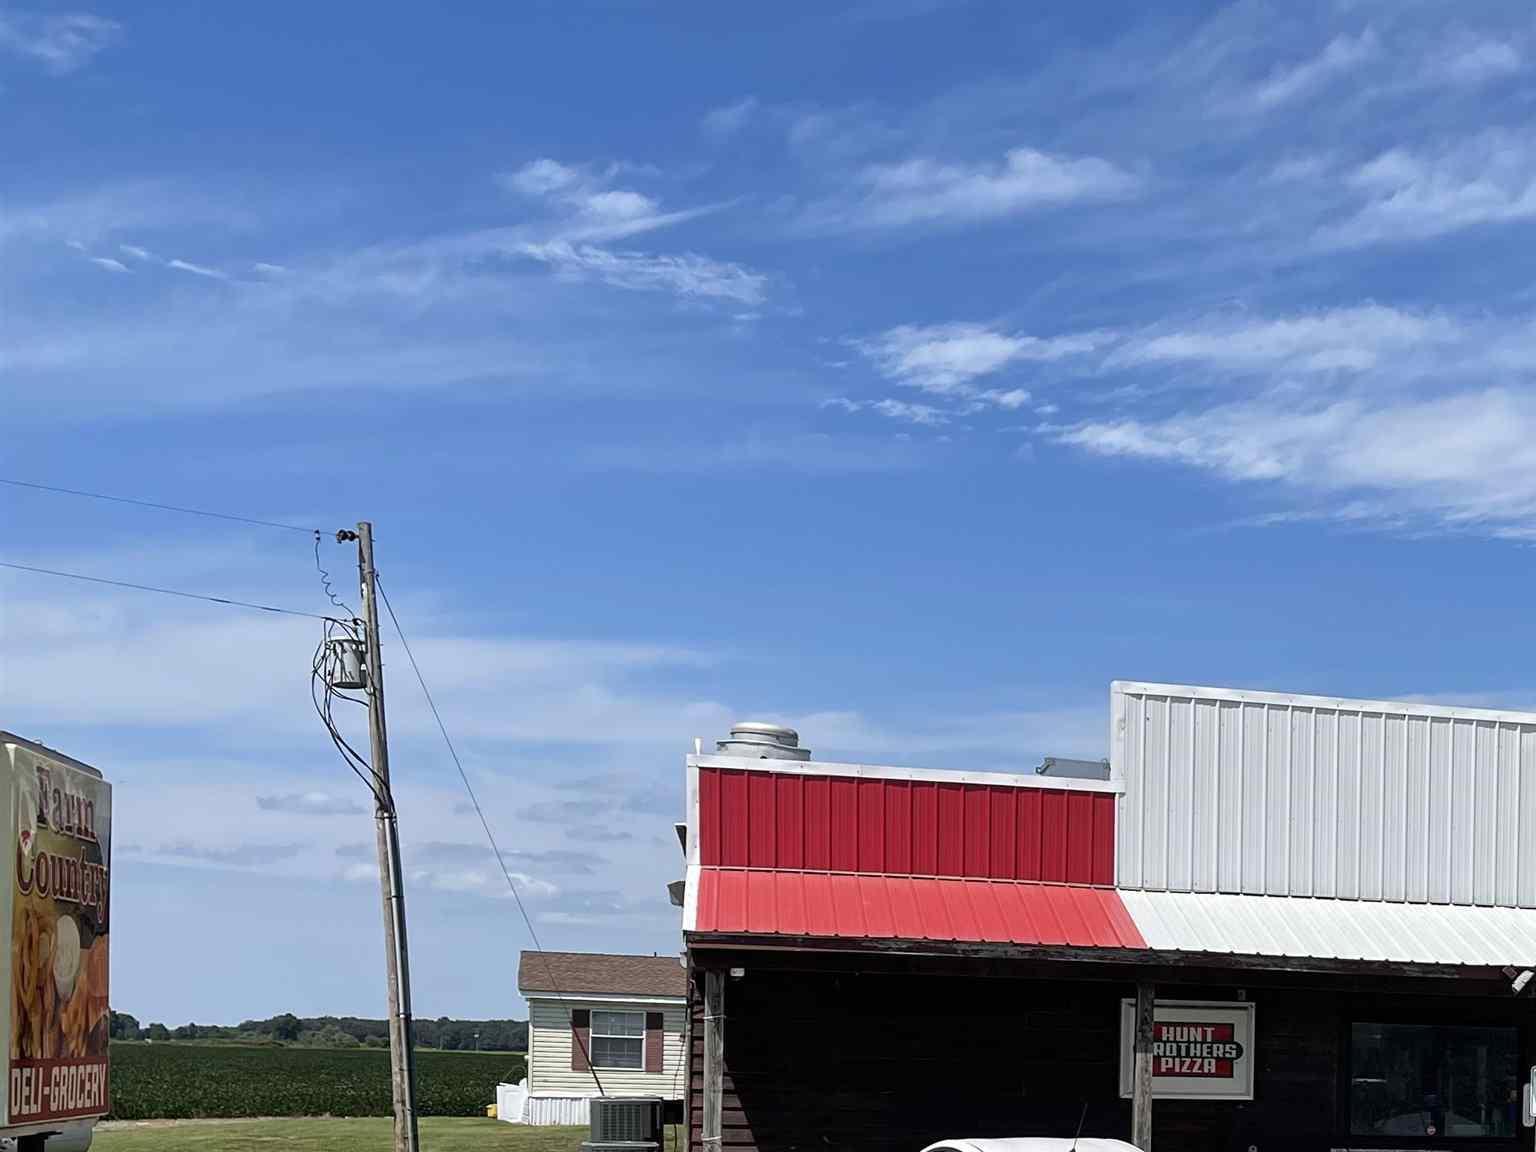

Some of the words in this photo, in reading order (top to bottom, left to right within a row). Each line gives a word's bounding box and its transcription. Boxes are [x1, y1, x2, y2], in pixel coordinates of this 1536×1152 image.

[35, 765, 97, 843] Farm
[16, 846, 107, 923] Country
[1153, 1042, 1237, 1058] ROTHERS
[1161, 1026, 1215, 1041] HUNT
[1160, 1058, 1216, 1073] PIZZA
[11, 1063, 106, 1116] DELI-GROCERY
